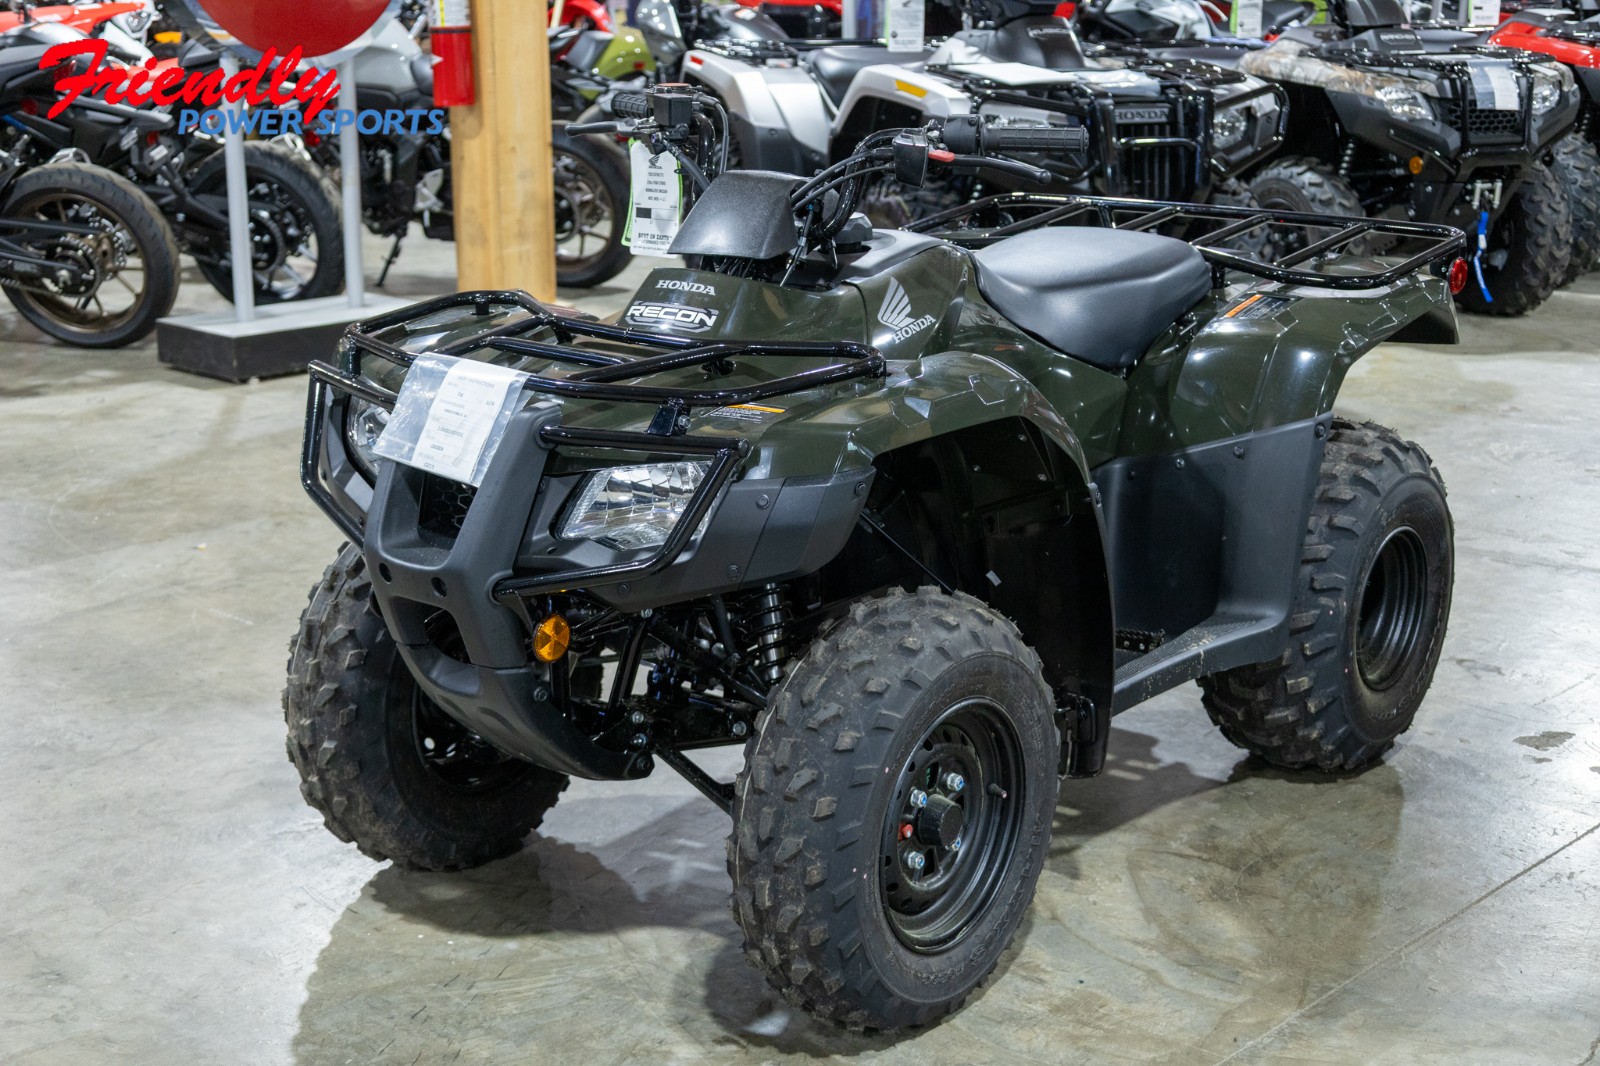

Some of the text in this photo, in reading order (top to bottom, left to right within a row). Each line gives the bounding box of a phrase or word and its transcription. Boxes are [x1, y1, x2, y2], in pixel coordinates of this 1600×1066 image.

[655, 279, 716, 296] HONDA
[626, 305, 718, 327] RECON
[891, 314, 937, 344] HONDA
